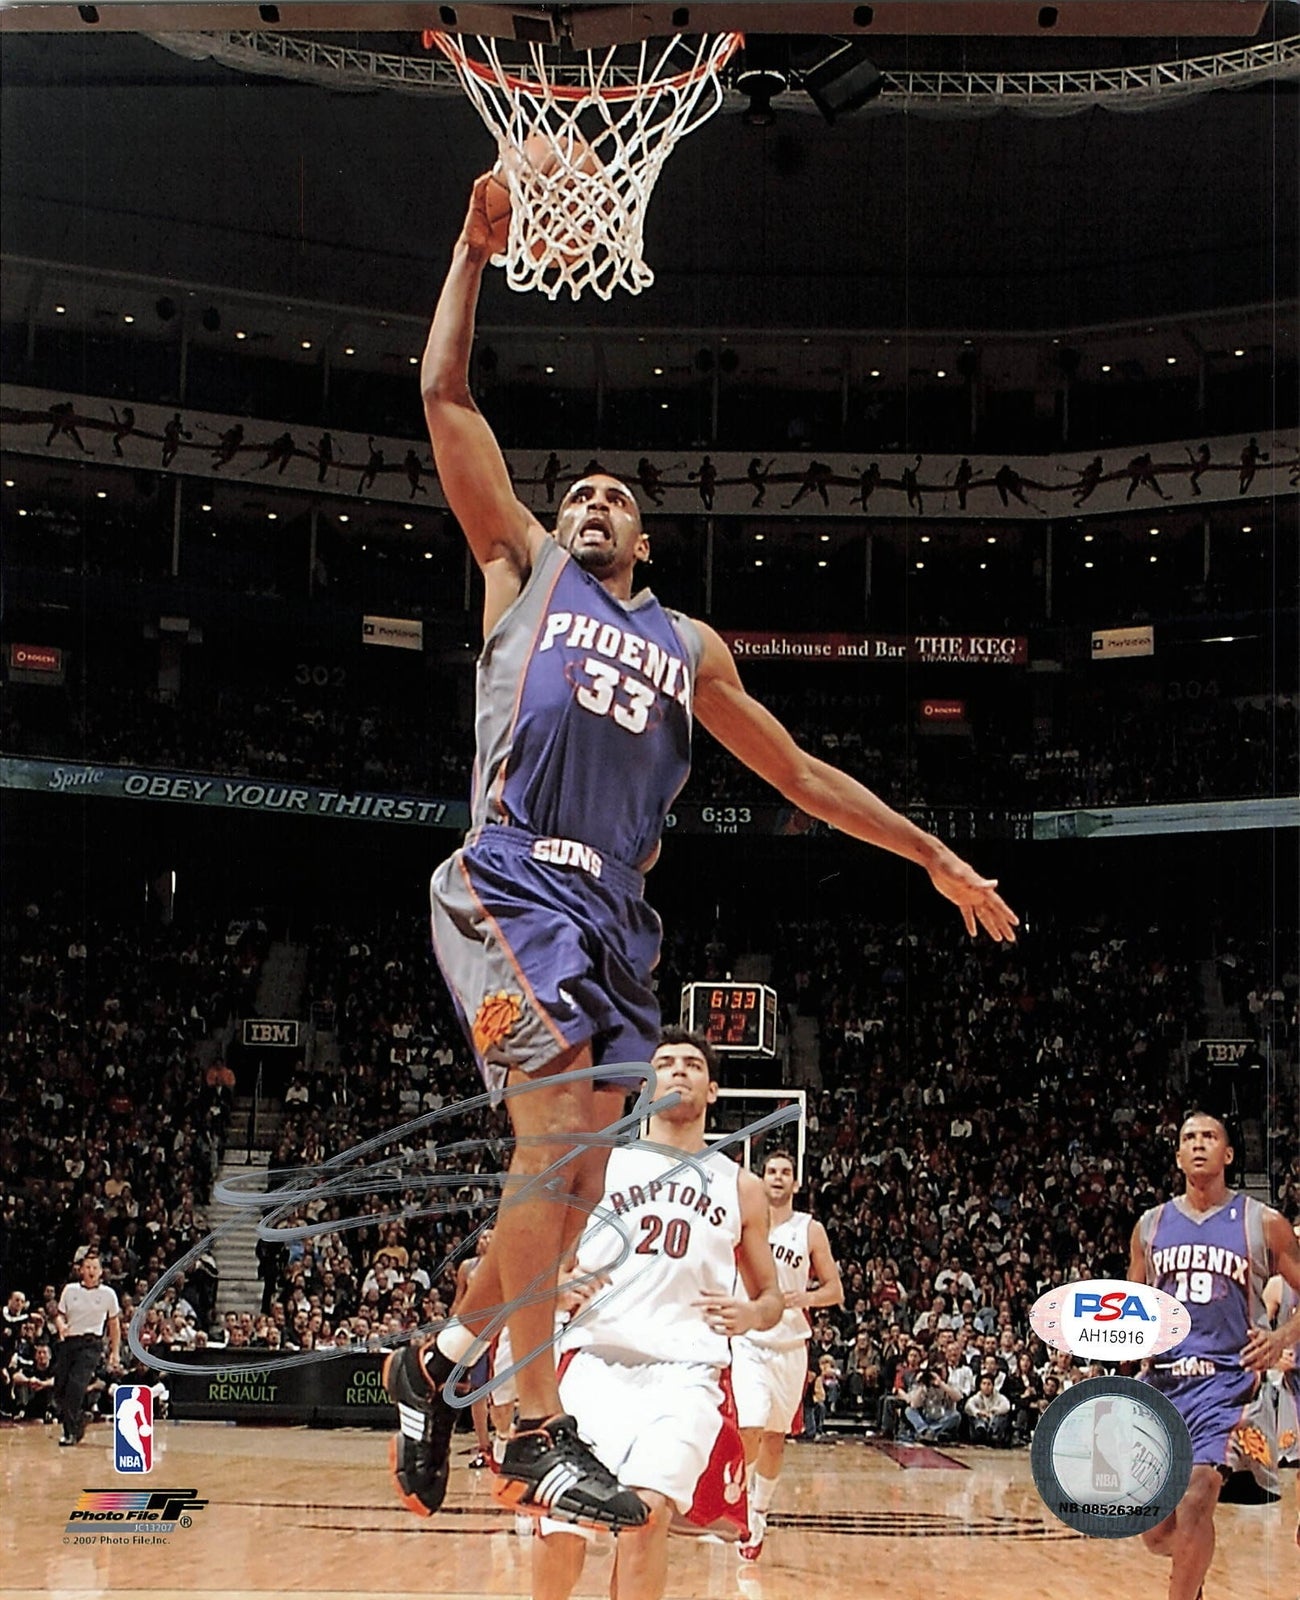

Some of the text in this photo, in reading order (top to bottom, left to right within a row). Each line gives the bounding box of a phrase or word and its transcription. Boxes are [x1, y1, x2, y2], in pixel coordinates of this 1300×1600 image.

[733, 639, 906, 658] Steakhouse and Bar
[915, 637, 1016, 655] THE KEG
[295, 664, 346, 686] 302
[577, 658, 655, 734] 33
[48, 766, 104, 791] Sprite
[124, 775, 446, 824] OBEY YOUR THIRST!
[702, 807, 752, 823] 6:33
[1004, 811, 1032, 822] Total
[714, 824, 738, 834] 3rd
[532, 839, 602, 878] SUNS
[250, 1024, 291, 1042] IBM
[1206, 1043, 1248, 1062] IBM
[610, 1181, 726, 1226] RAPTORS
[635, 1215, 691, 1259] 20
[769, 1243, 803, 1269] TORS
[1153, 1244, 1249, 1285] PHOENIX
[1175, 1271, 1213, 1304] 19
[1074, 1292, 1150, 1321] PSA
[1078, 1328, 1144, 1345] AH15916
[215, 1369, 272, 1384] OGILVY
[353, 1371, 381, 1386] OGI
[209, 1384, 278, 1402] RENAULT
[346, 1388, 396, 1405] RENA
[1095, 1473, 1118, 1488] NBA
[1059, 1502, 1078, 1513] NB
